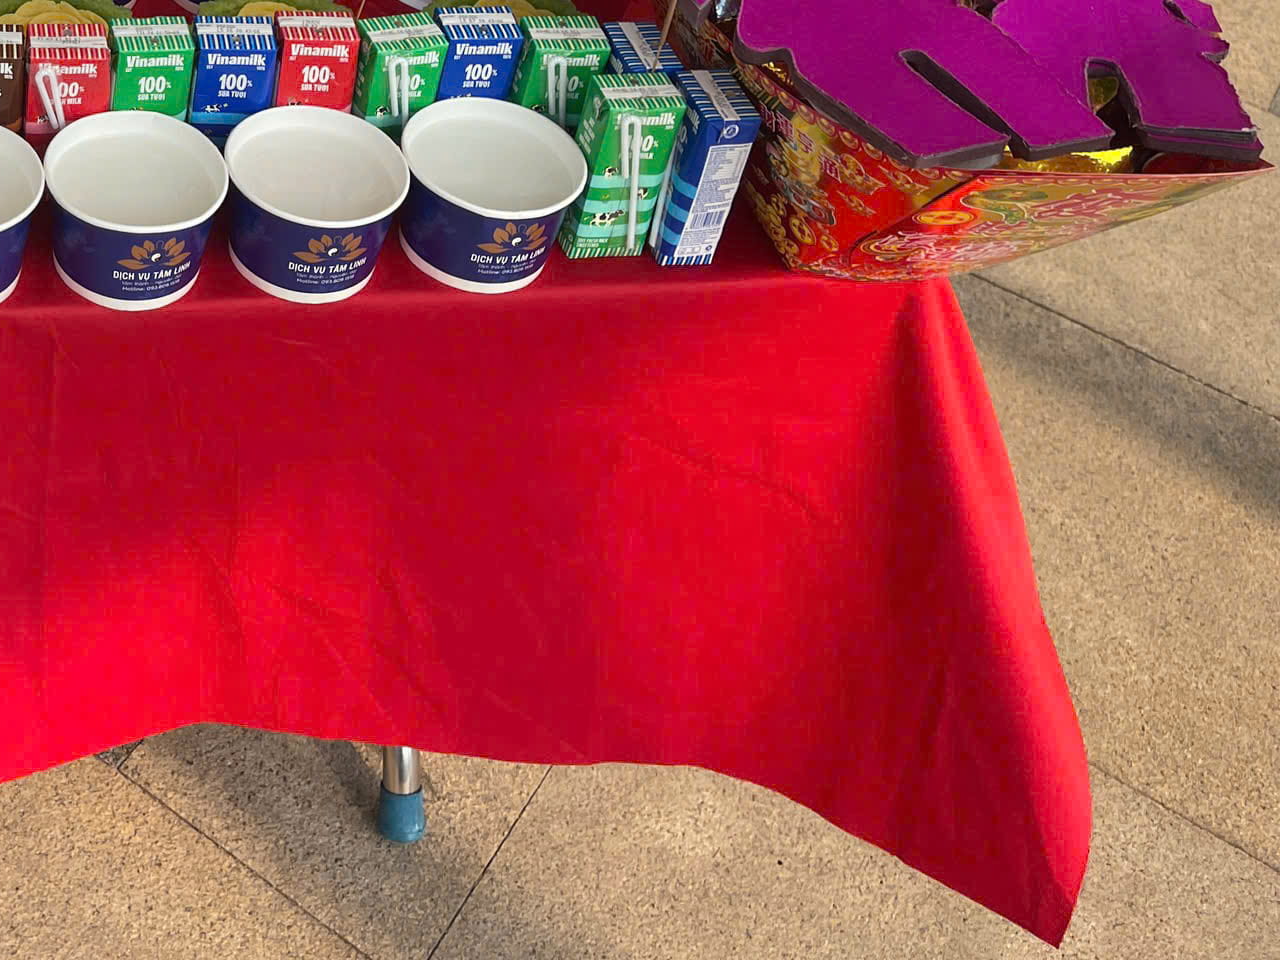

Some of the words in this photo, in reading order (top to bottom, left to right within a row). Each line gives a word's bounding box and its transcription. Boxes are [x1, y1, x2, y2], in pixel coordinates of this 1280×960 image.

[291, 44, 350, 58] Vinamilk
[456, 43, 512, 56] Vinamilk
[126, 54, 184, 68] Vinamilk
[208, 54, 266, 66] Vinamilk
[302, 66, 336, 84] 100%
[465, 64, 498, 81] 100%
[138, 76, 172, 94] 100%
[219, 74, 253, 90] 100%
[288, 262, 310, 273] DỊCH
[314, 264, 326, 274] VỤ
[328, 264, 348, 274] TÂM
[349, 256, 367, 270] LINH
[470, 253, 492, 264] DỊCH
[496, 256, 508, 265] VỤ
[510, 254, 529, 264] TÂM
[112, 270, 135, 281] DỊCH
[138, 272, 150, 282] VỤ
[153, 269, 172, 280] TÂM
[174, 260, 192, 275] LINH
